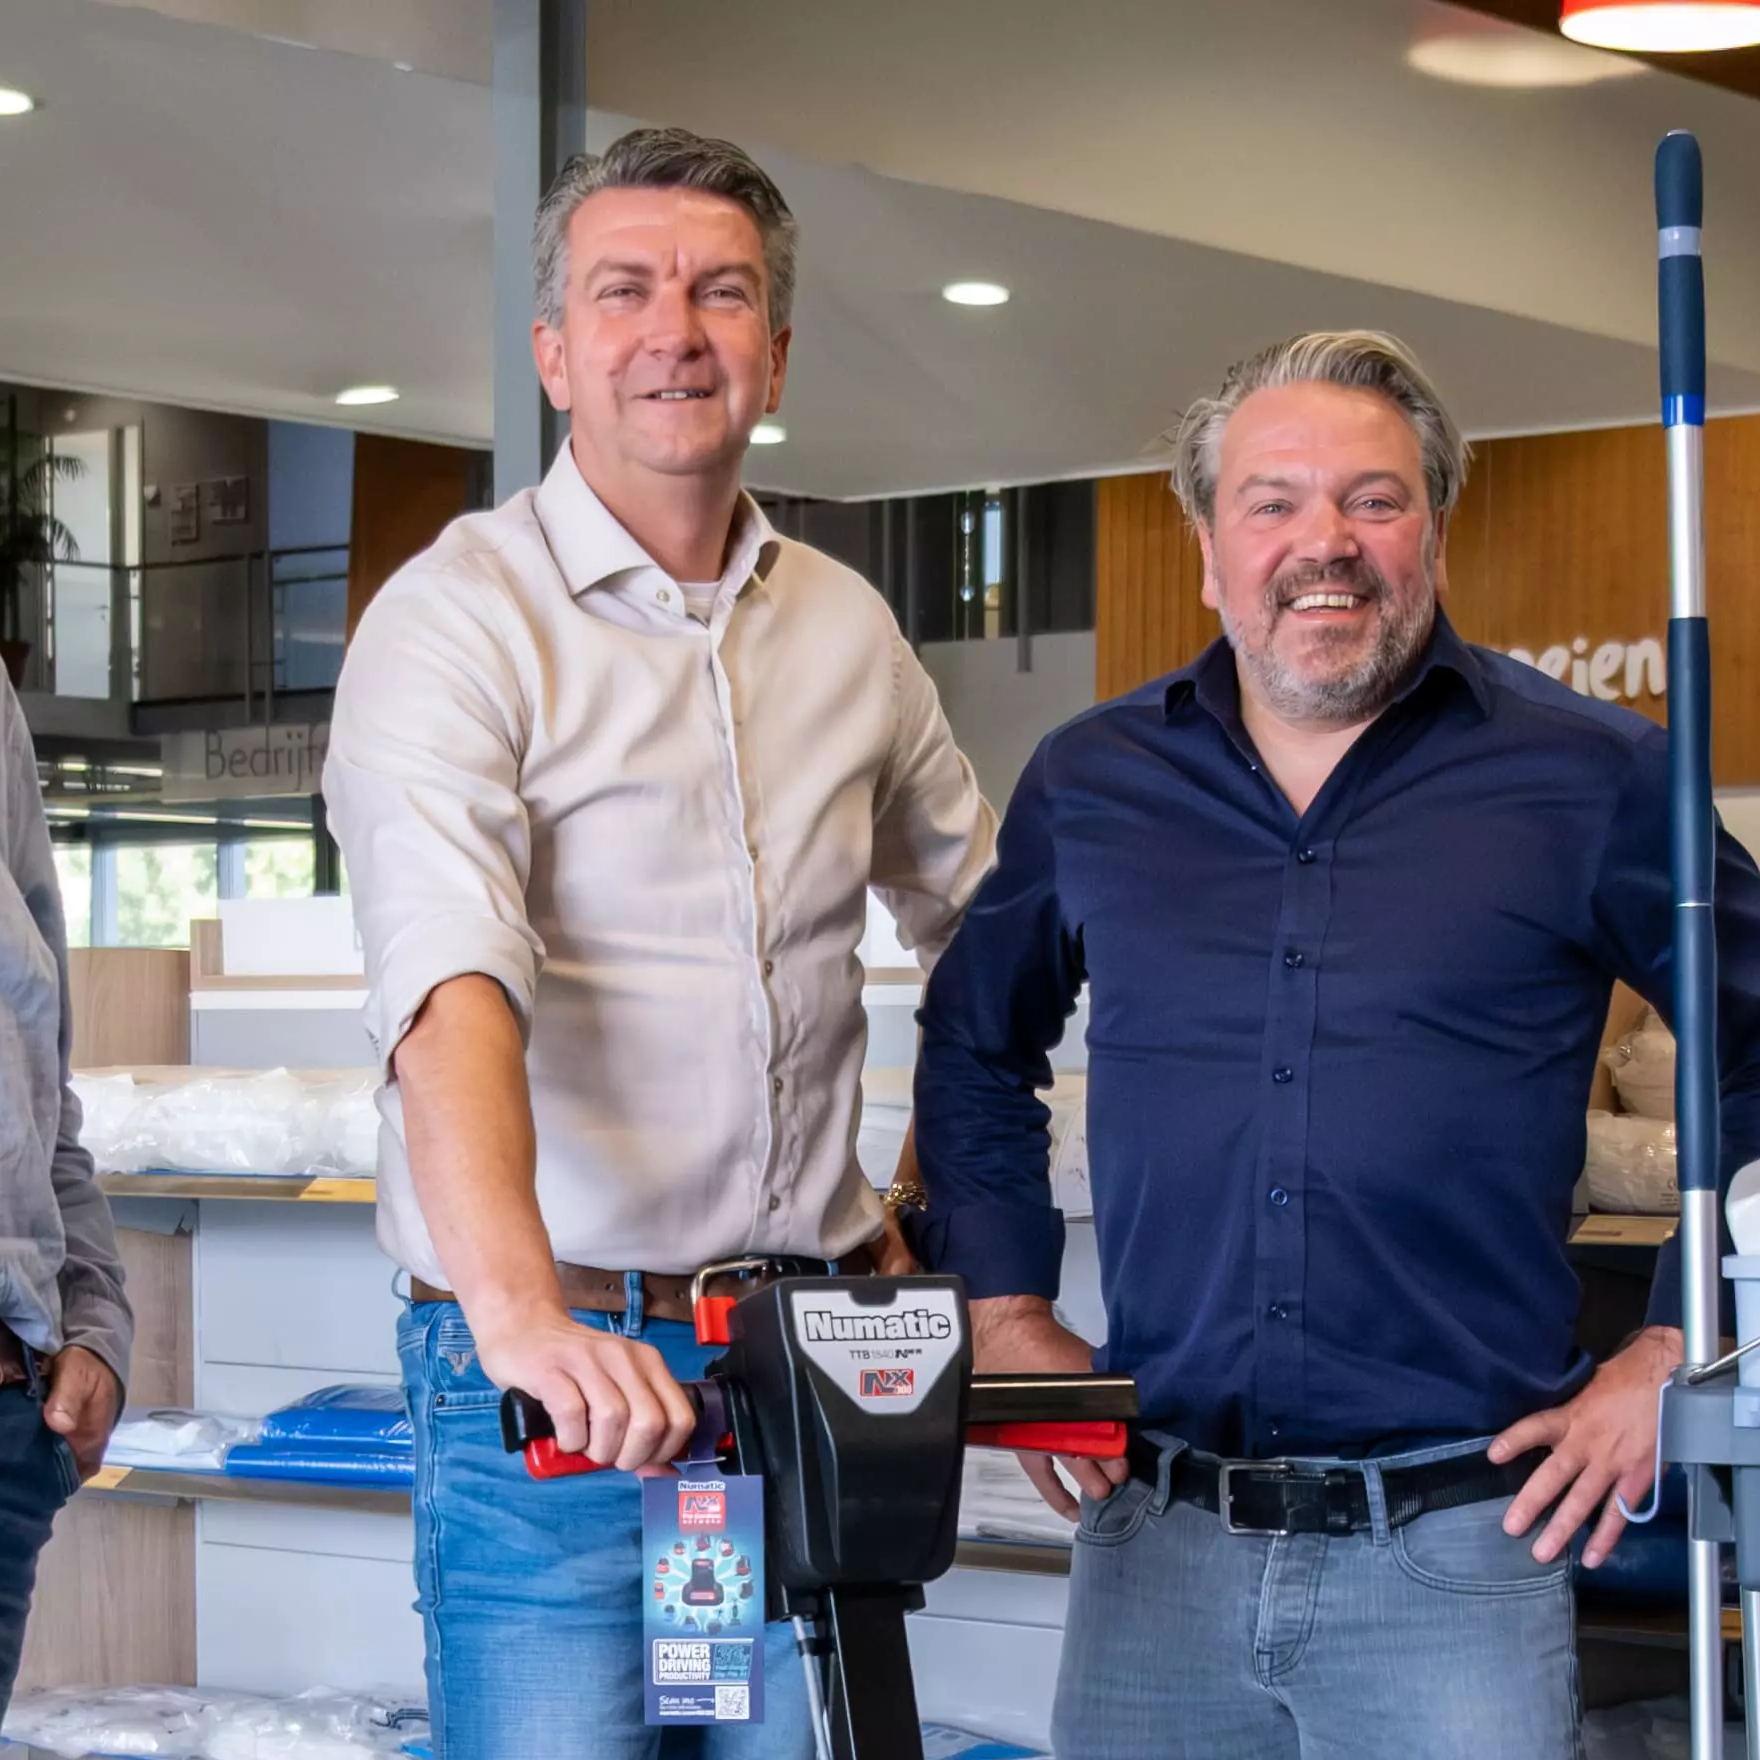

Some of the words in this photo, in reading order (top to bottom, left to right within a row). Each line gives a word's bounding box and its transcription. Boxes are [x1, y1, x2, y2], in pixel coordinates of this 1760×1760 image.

[205, 727, 328, 792] Bedrijf
[804, 1309, 951, 1341] Numatic
[659, 1643, 710, 1658] POWER
[659, 1658, 711, 1673] DRIVING
[659, 1672, 710, 1681] PRODUCTIVITY
